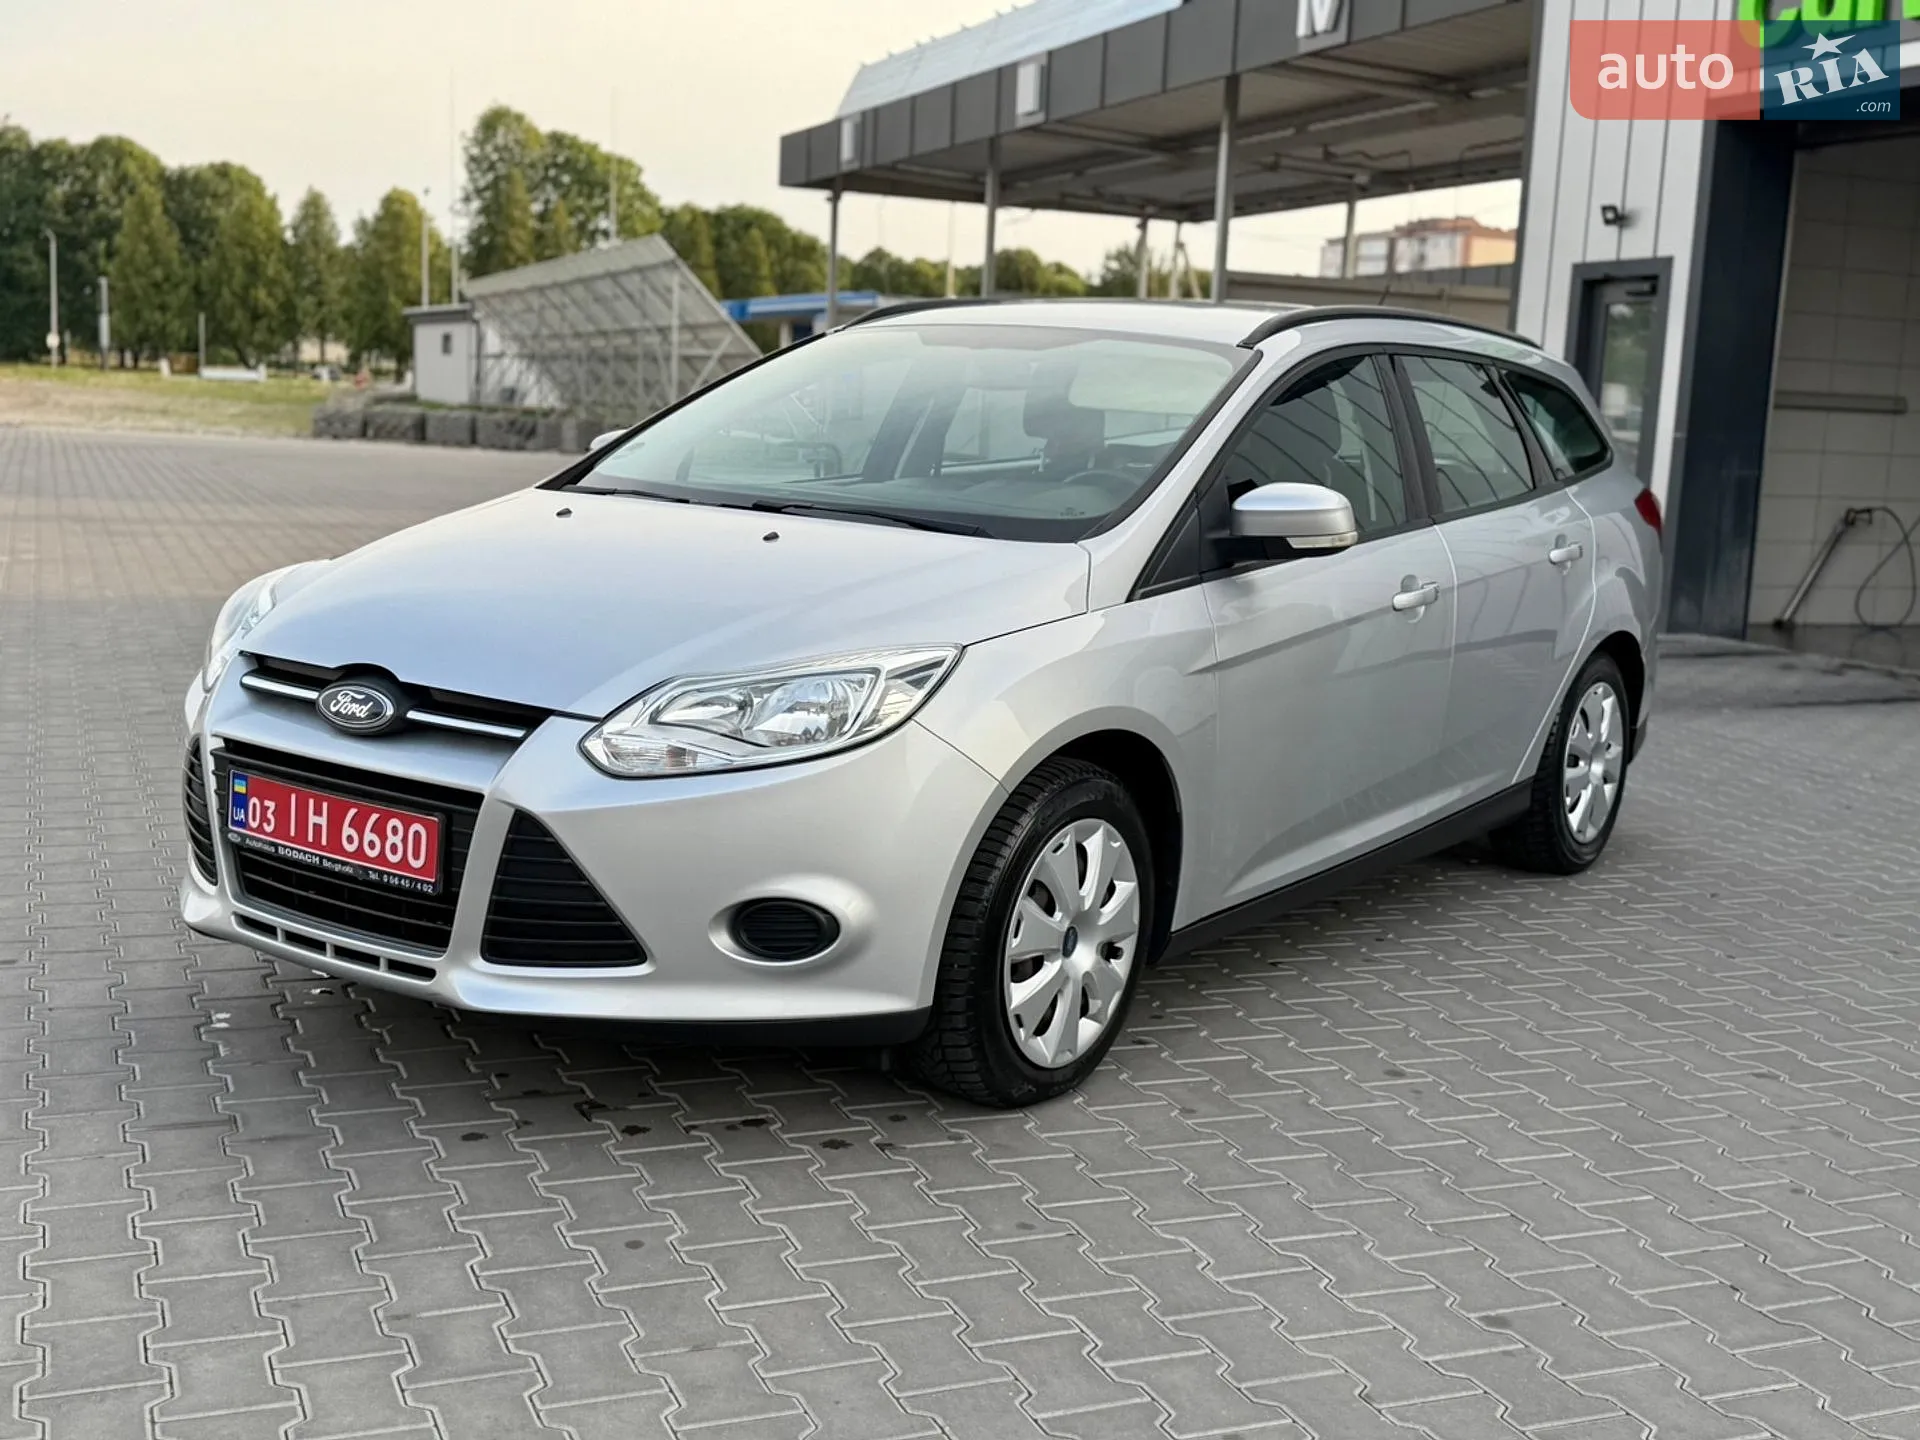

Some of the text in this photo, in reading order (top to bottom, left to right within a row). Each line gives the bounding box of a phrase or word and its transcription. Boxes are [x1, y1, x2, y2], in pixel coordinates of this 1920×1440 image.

[330, 690, 373, 718] Ford
[233, 806, 246, 823] UA
[248, 796, 276, 833] 03
[341, 808, 427, 869] 6680
